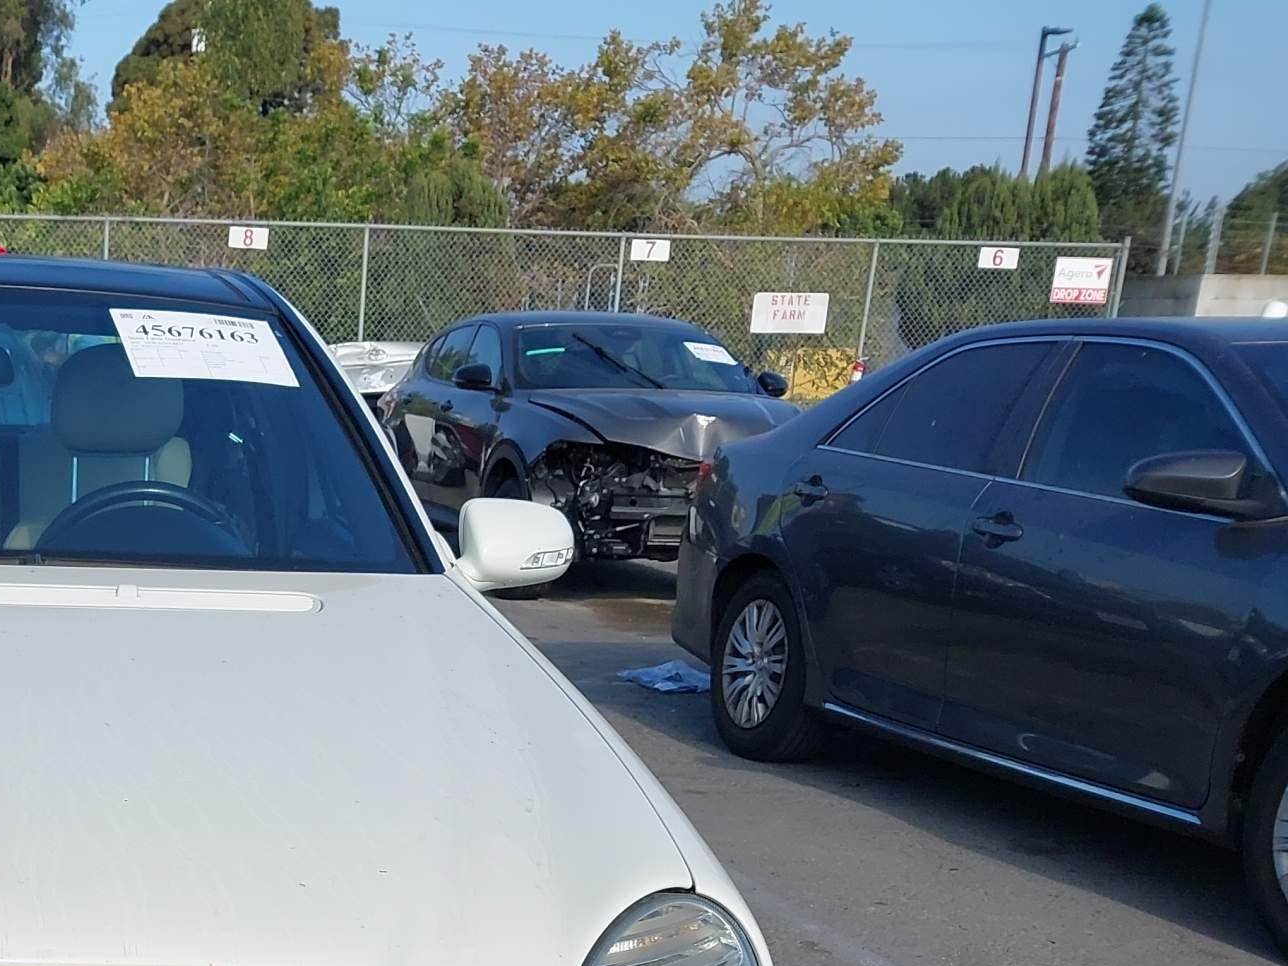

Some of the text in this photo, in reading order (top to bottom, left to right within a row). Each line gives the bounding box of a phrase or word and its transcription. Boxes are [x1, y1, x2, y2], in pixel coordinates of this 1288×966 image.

[243, 228, 254, 247] 8
[646, 241, 657, 259] 7
[992, 249, 1005, 266] 6
[1057, 266, 1093, 281] Agero
[771, 294, 810, 306] STATE
[1053, 288, 1106, 300] DROP ZONE
[772, 309, 806, 321] FARM
[135, 323, 259, 345] 45676163
